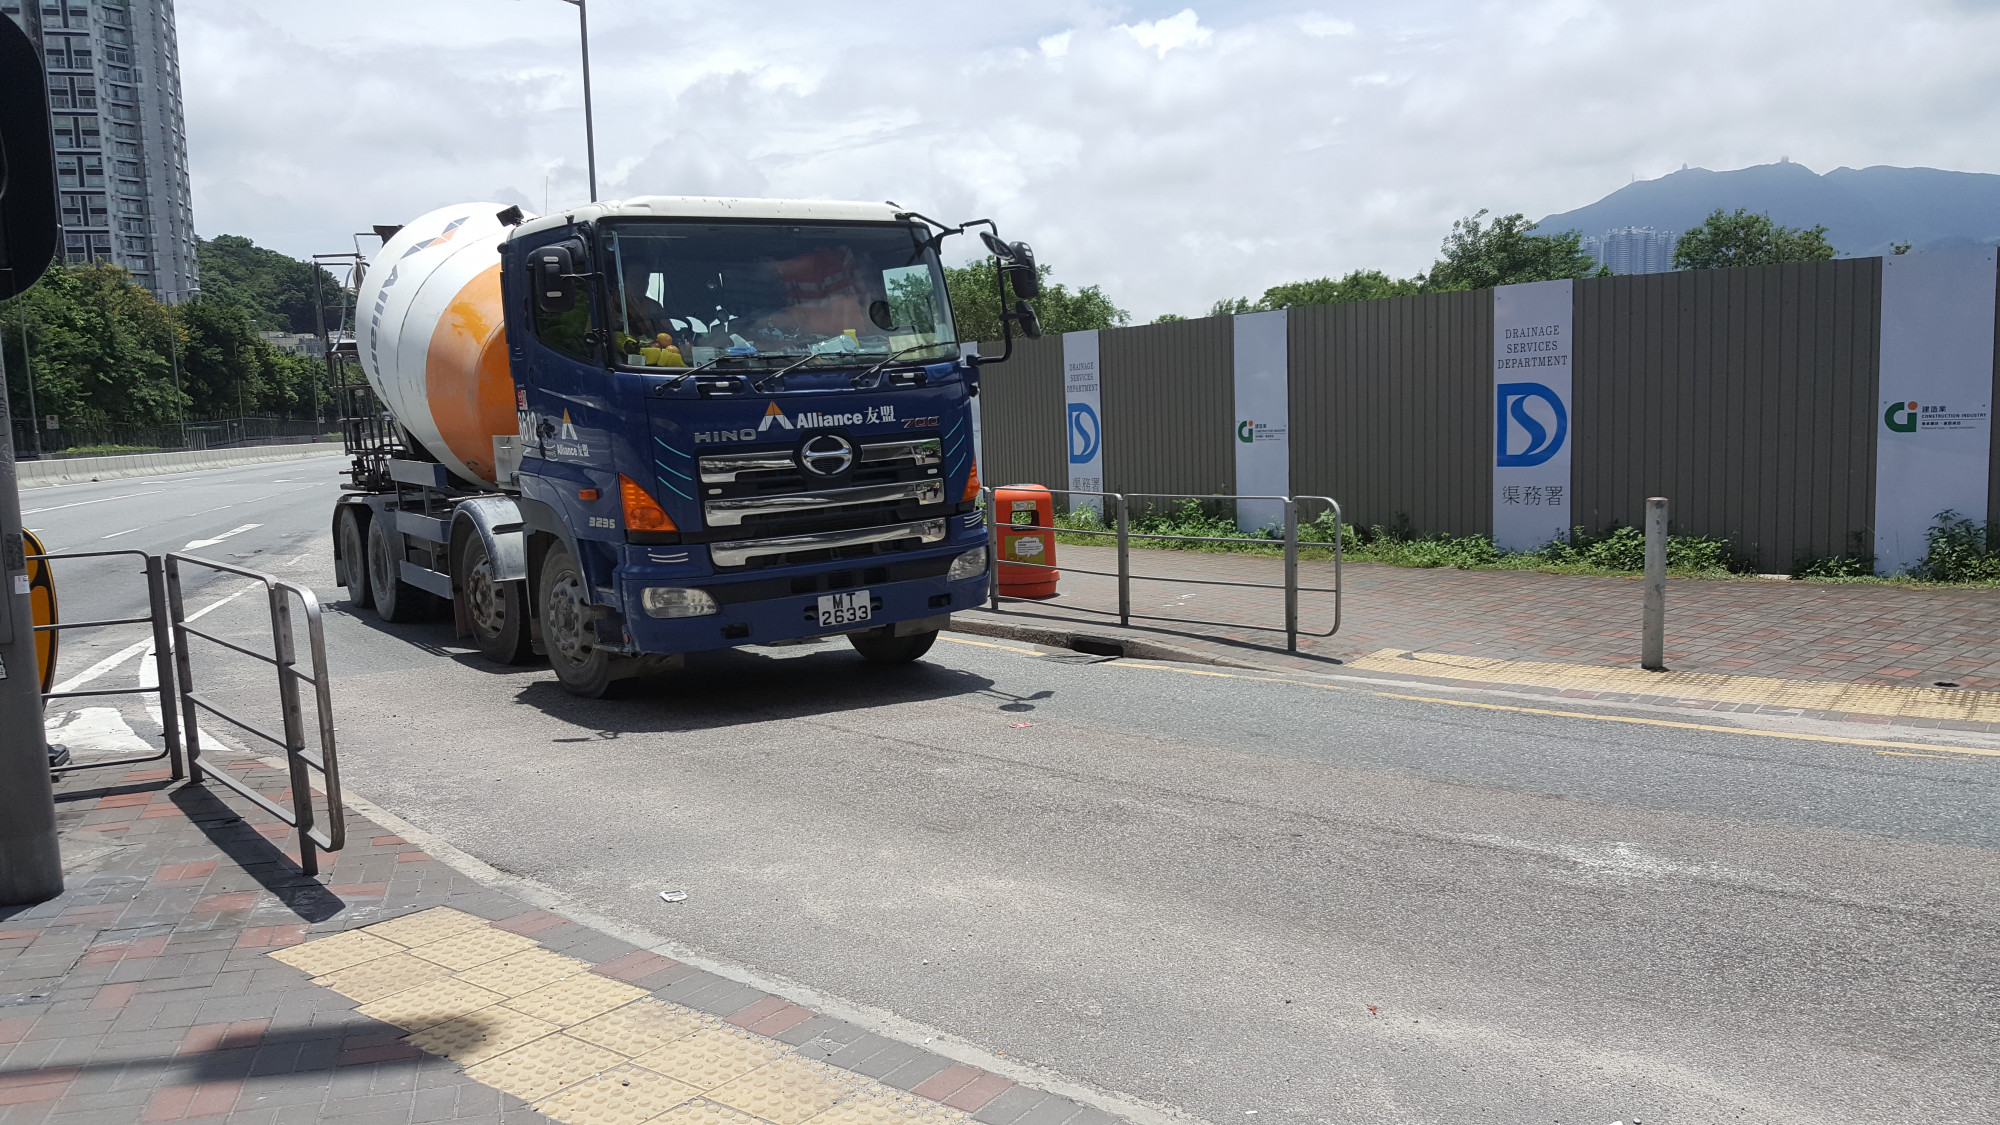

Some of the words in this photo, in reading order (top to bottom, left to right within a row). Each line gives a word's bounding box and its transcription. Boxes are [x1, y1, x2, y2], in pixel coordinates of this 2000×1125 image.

[1505, 325, 1560, 338] DRAINAGE
[1506, 340, 1558, 354] SERVICES
[1498, 355, 1567, 369] DEPARTMENT
[796, 411, 863, 429] Alliance
[863, 405, 897, 424] 友盟
[901, 415, 941, 429] 700
[694, 428, 757, 443] HINO
[1502, 485, 1564, 506] 渠務署
[832, 592, 856, 610] MT
[821, 605, 869, 626] 2633
